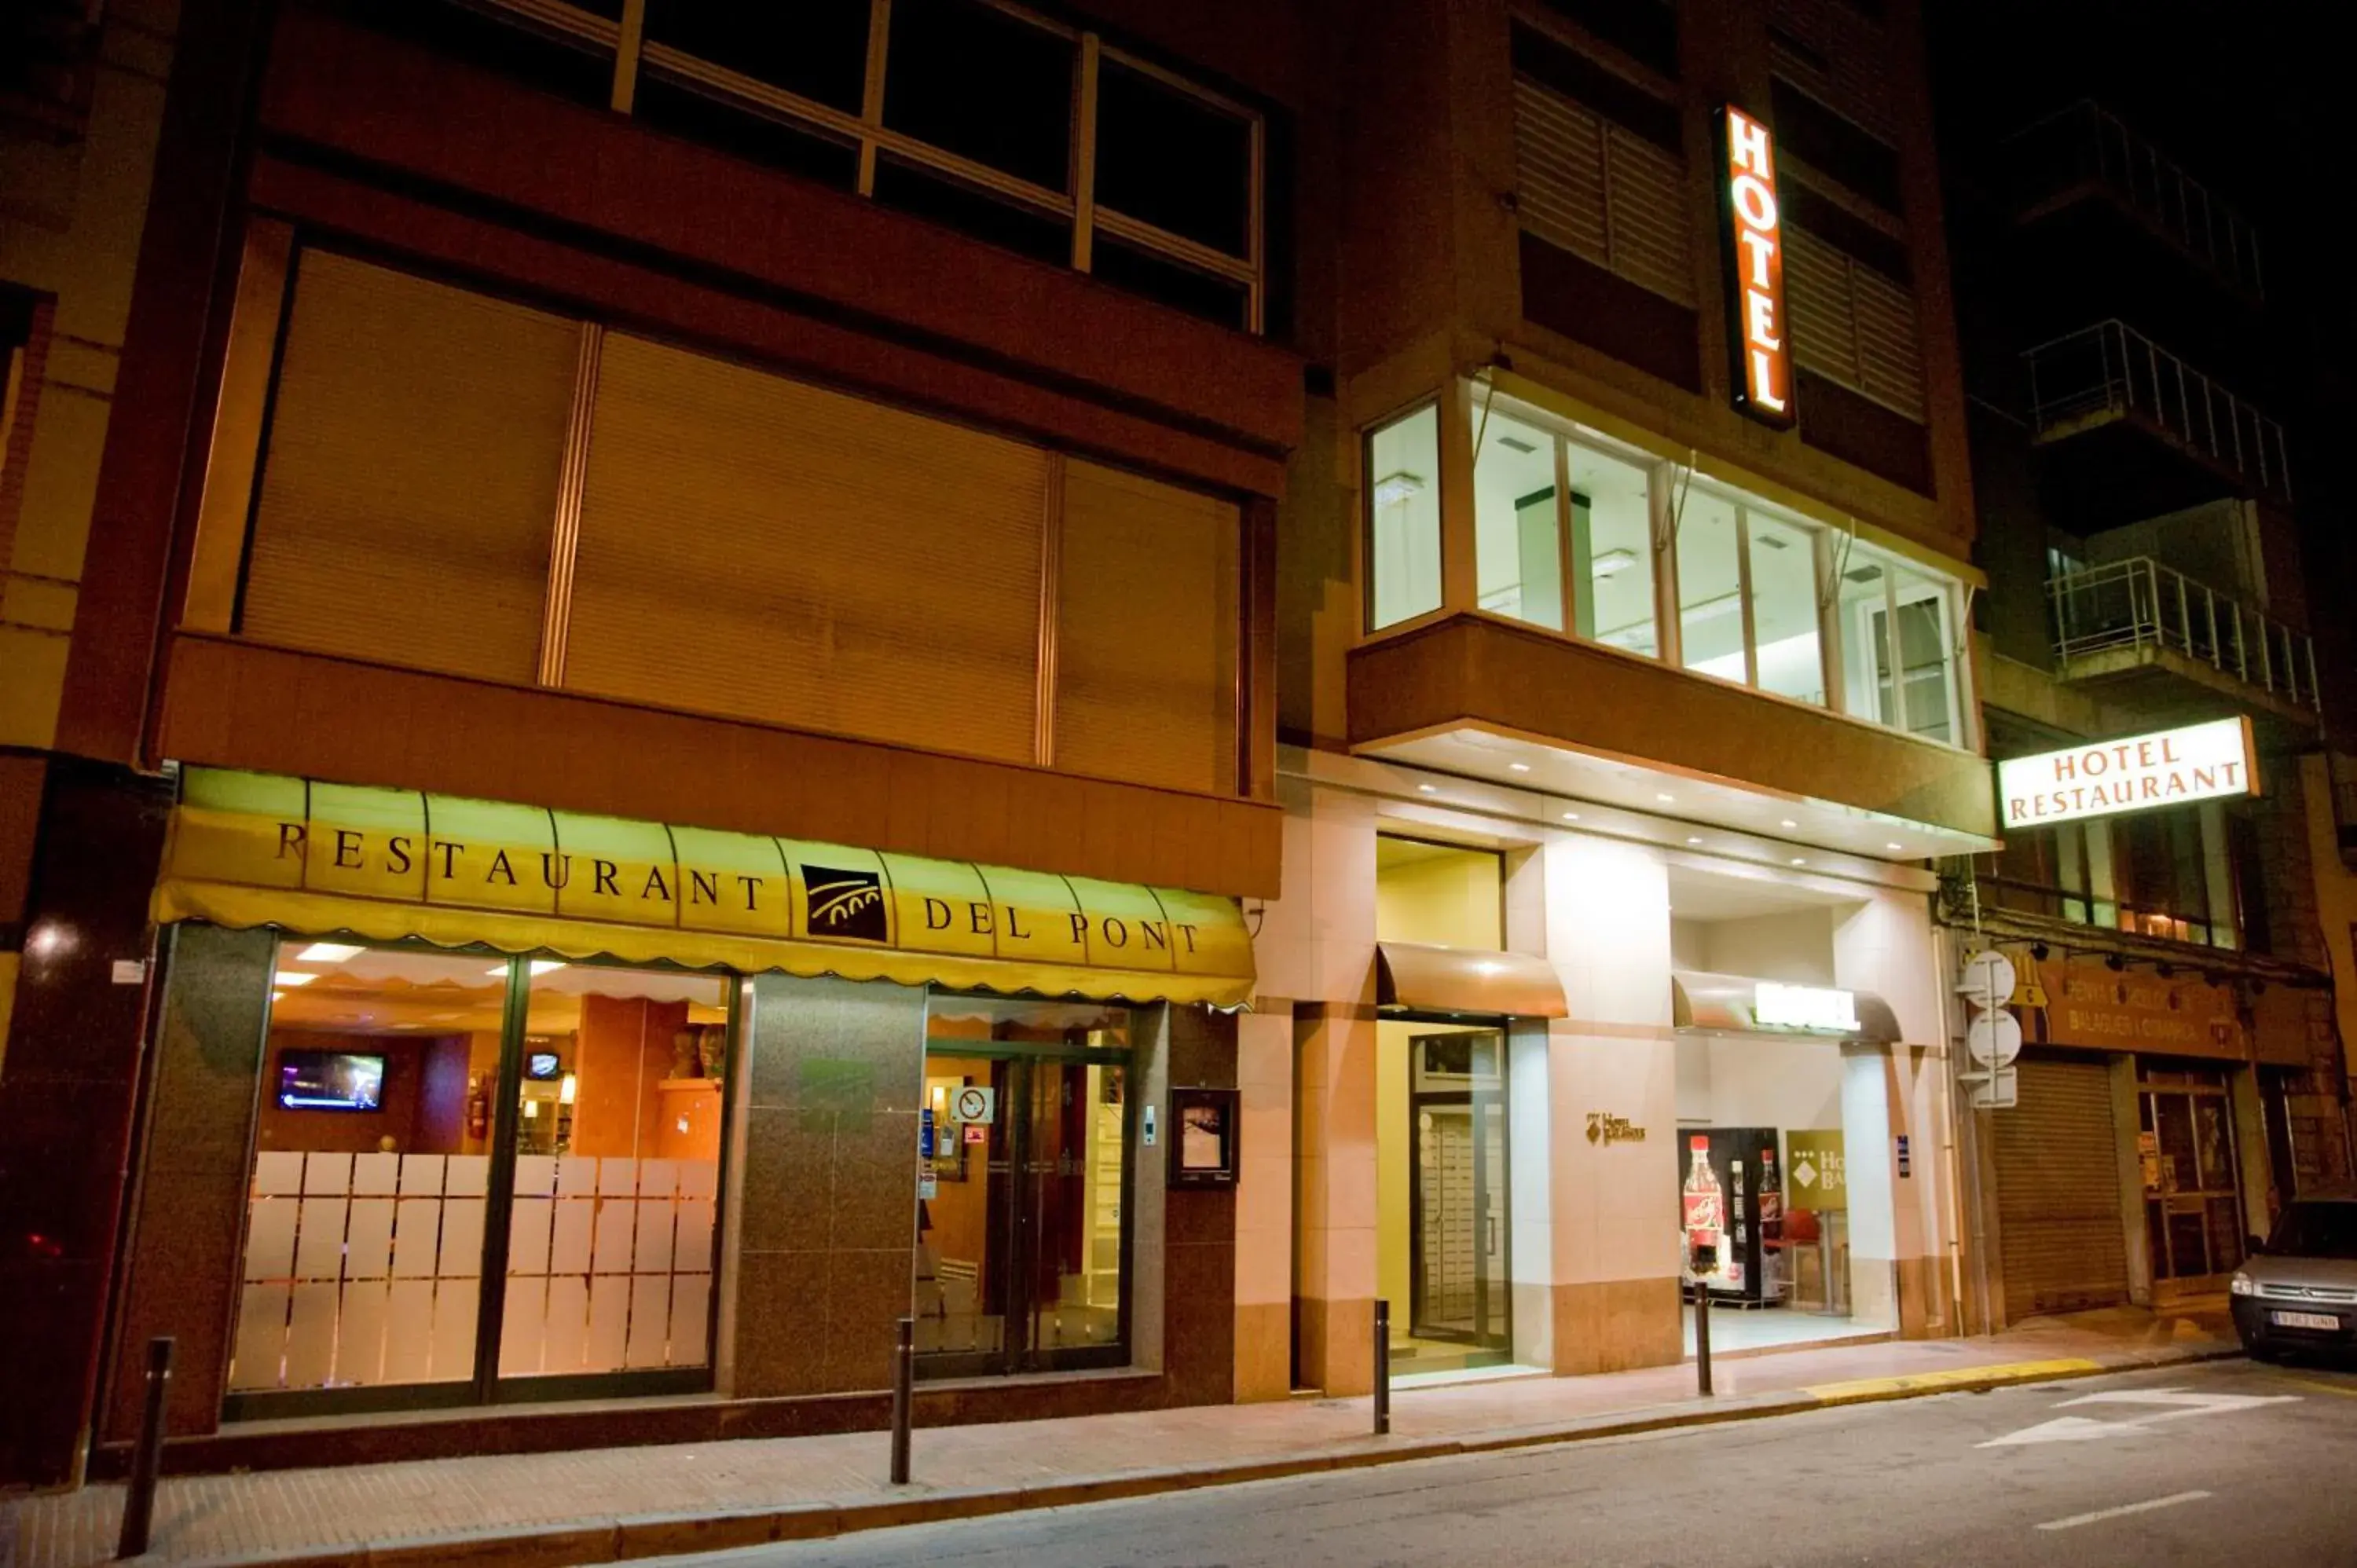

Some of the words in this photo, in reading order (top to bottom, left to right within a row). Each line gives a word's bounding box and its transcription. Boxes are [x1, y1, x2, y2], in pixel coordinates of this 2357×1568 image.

[1730, 112, 1786, 412] HOTEL
[2010, 761, 2239, 821] RESTAURANT
[2054, 738, 2181, 782] HOTEL
[275, 822, 764, 910] RESTAURANT
[923, 897, 1032, 939] DEL
[1069, 913, 1197, 953] PONT
